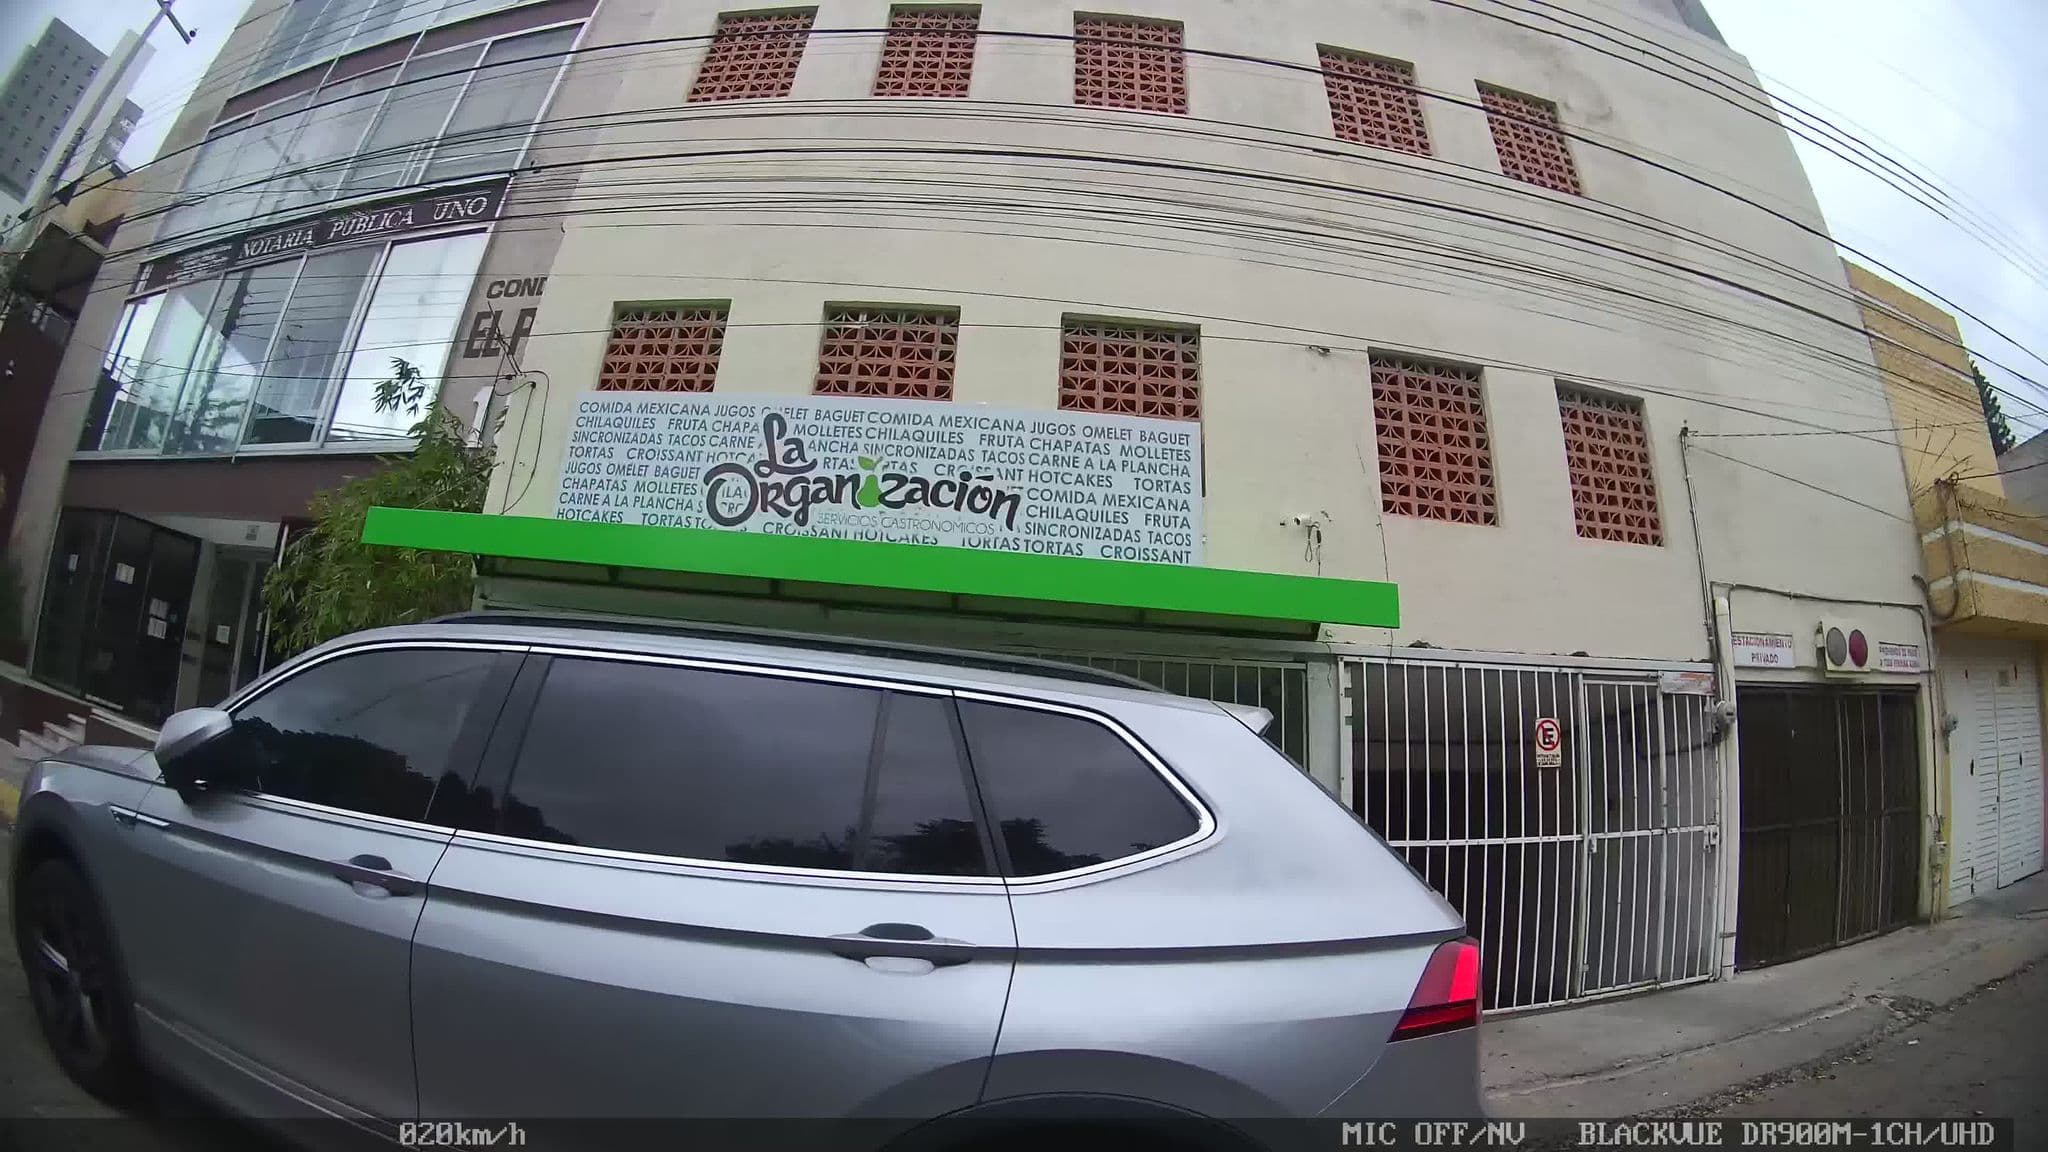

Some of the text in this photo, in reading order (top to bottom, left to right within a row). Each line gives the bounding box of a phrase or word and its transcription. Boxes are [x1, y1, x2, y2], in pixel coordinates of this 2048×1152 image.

[239, 227, 314, 259] NOTARIA
[433, 197, 488, 220] UNO
[463, 310, 503, 358] EL
[575, 416, 1192, 462] CHILAQUILES FRUTA CHAPA MOLLETES CHILAQUILES FRUTA CHAPATAS MOLLETES
[579, 401, 1191, 447] COMIDA MEXICANA JUGOS OELET BAGUET COMIDA MEXICANA JUGOS OMELET BAGUET
[754, 412, 818, 478] La
[569, 446, 614, 459] TORTAS
[626, 447, 704, 462] CROISSANT
[706, 451, 757, 465] HOTCA
[934, 463, 1024, 481] CRSSANT
[1028, 469, 1113, 489] HOTCAKES
[1134, 477, 1192, 495] TORTAS
[572, 431, 663, 445] SINCRONIZADAS
[668, 433, 706, 447] TACOS
[709, 435, 756, 448] CARNE
[808, 440, 859, 454] ANCHA
[863, 443, 975, 462] SINCRONIZADAS
[981, 449, 1025, 465] TACOS
[1028, 452, 1080, 469] CARNE
[1084, 457, 1095, 470] A
[1099, 458, 1117, 472] LA
[1121, 460, 1191, 478] PLANCHA
[562, 477, 627, 492] CHAPATAS
[633, 480, 698, 496] MOLLETES
[1026, 504, 1129, 525] CHILAQUILES
[1144, 513, 1191, 530] FRUTA
[565, 461, 1191, 512] JUGOS OMELET BAGUET COMIDA MEXICANA
[556, 508, 624, 524] HOTCAKES
[641, 512, 691, 528] TORTAS
[1024, 539, 1084, 556] TORTAS
[1100, 544, 1192, 564] CROISSANT
[559, 492, 600, 506] CARNE
[601, 496, 611, 507] A
[614, 496, 629, 507] LA
[632, 496, 694, 511] PLANCHA
[1024, 521, 1141, 543] SINCRONIZADAS
[1147, 530, 1192, 547] TACOS
[817, 512, 878, 528] SERVICIOS
[1751, 652, 1779, 664] PRIVADO
